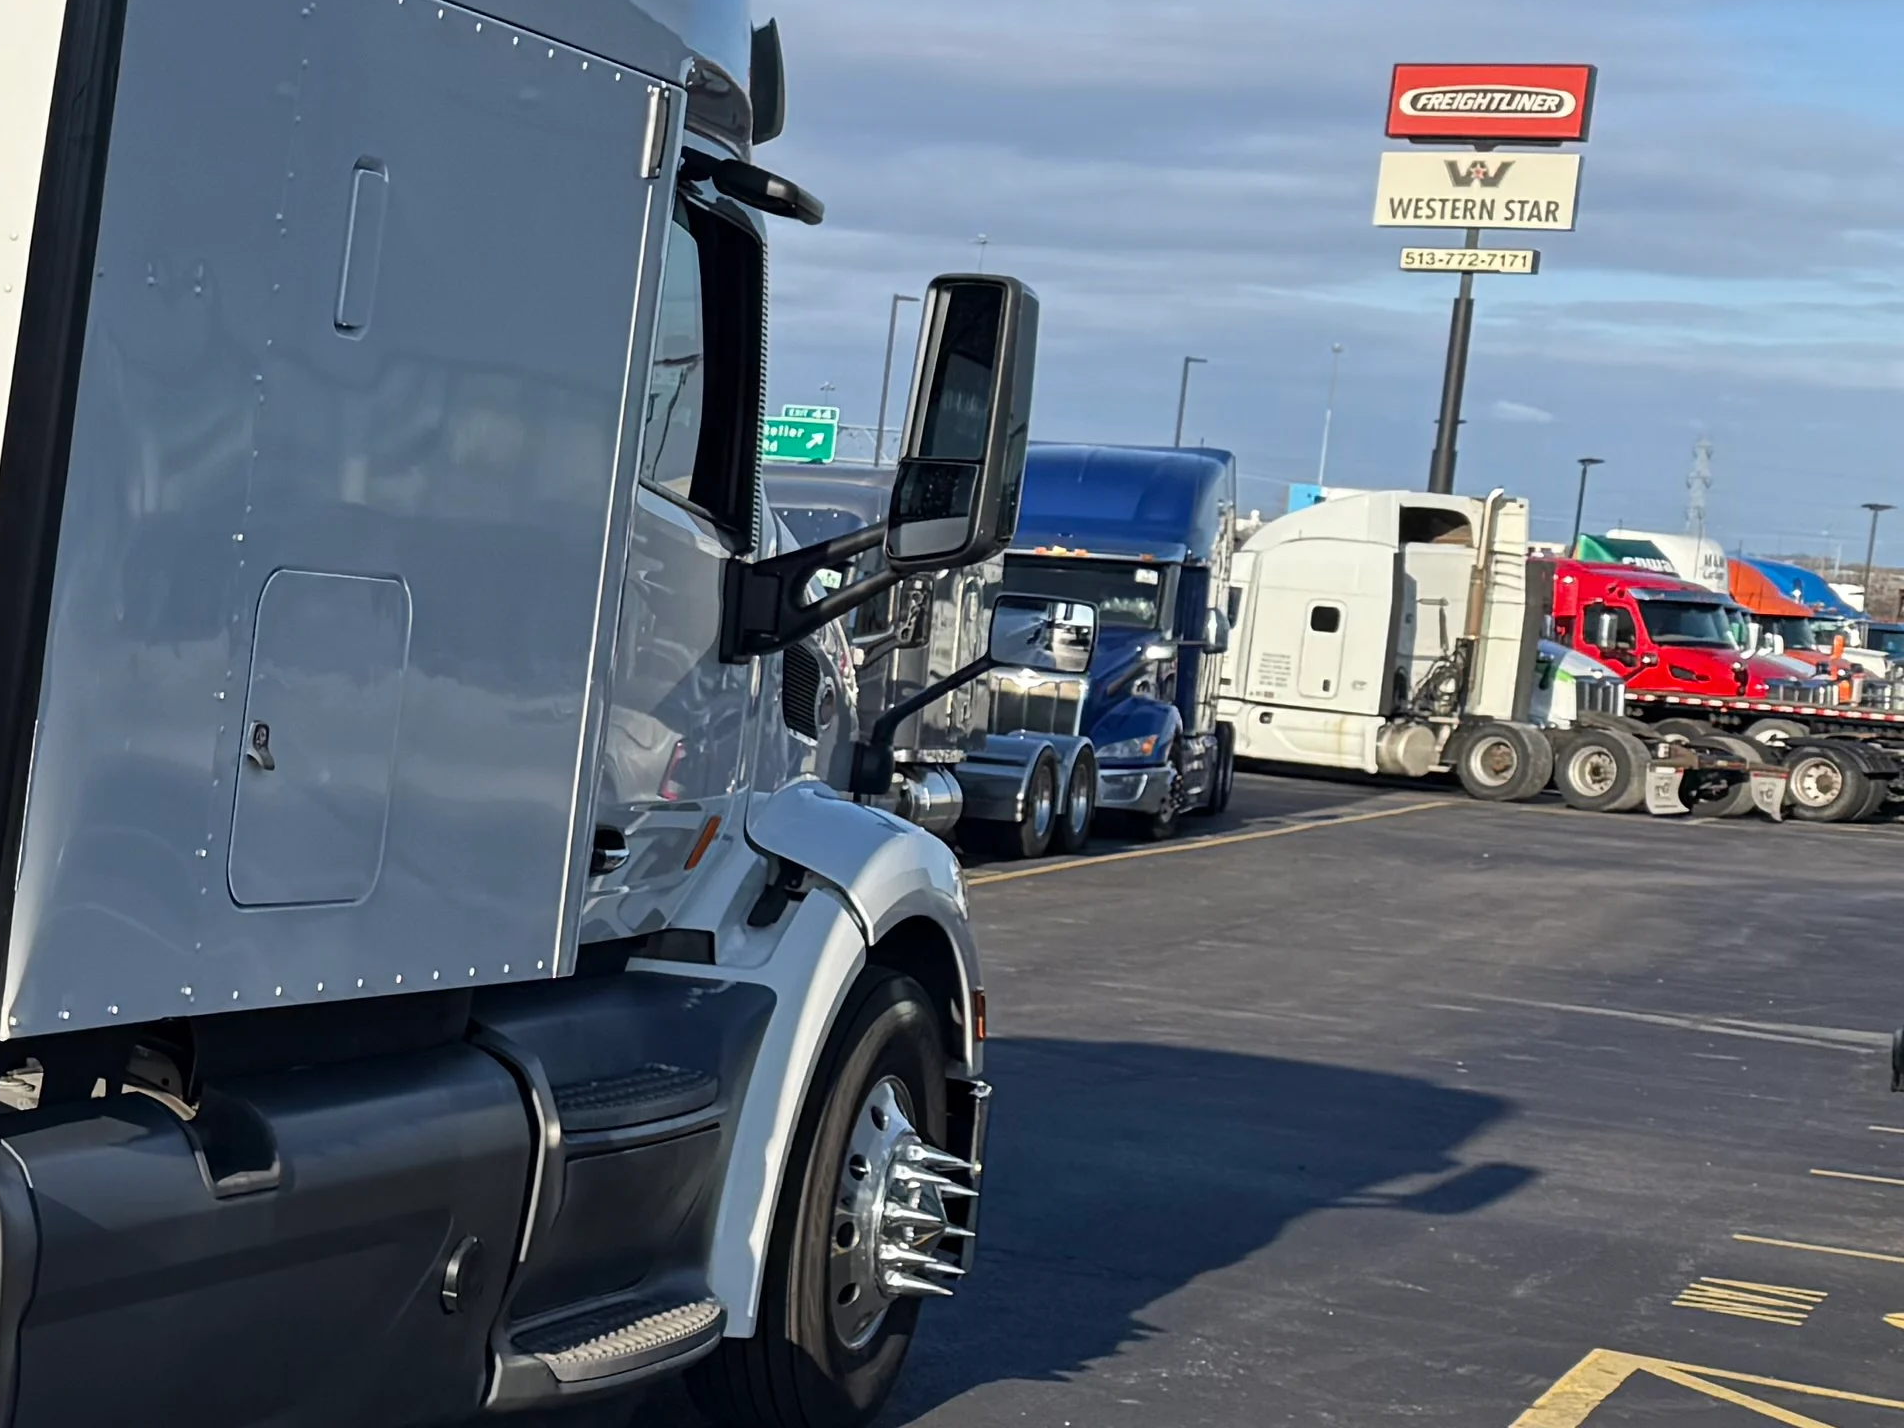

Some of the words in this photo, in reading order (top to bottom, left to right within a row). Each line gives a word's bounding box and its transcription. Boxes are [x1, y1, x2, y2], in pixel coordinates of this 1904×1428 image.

[1416, 92, 1562, 112] FREIGHTLINER
[1389, 197, 1496, 221] WESTERN
[1503, 200, 1560, 222] STAR
[1404, 252, 1529, 269] 513-772-7171
